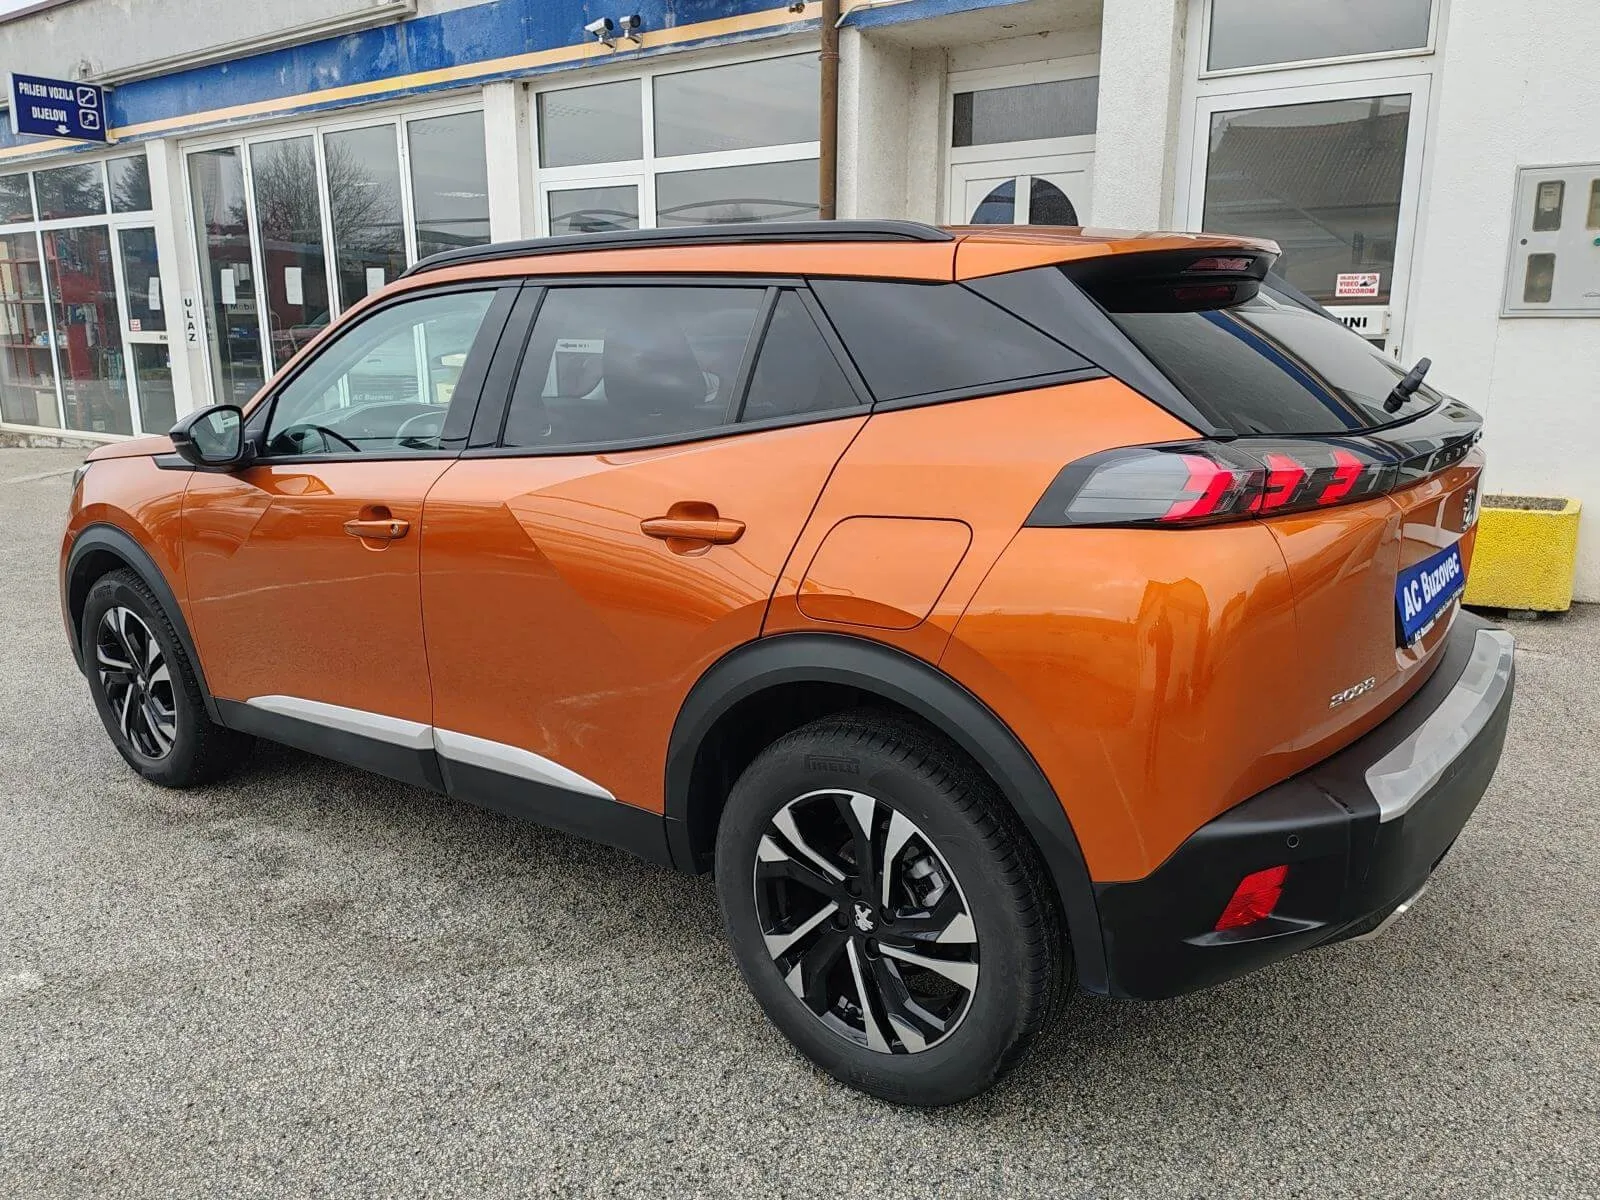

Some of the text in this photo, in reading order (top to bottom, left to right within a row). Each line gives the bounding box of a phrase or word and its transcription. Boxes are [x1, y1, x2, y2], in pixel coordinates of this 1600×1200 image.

[18, 82, 75, 101] PRIJEM VOZILA
[31, 106, 67, 122] DIJELOVI
[184, 298, 196, 342] ULAZ
[1403, 579, 1422, 622] AC
[1420, 552, 1460, 604] Buzovec
[1328, 676, 1377, 709] 2008
